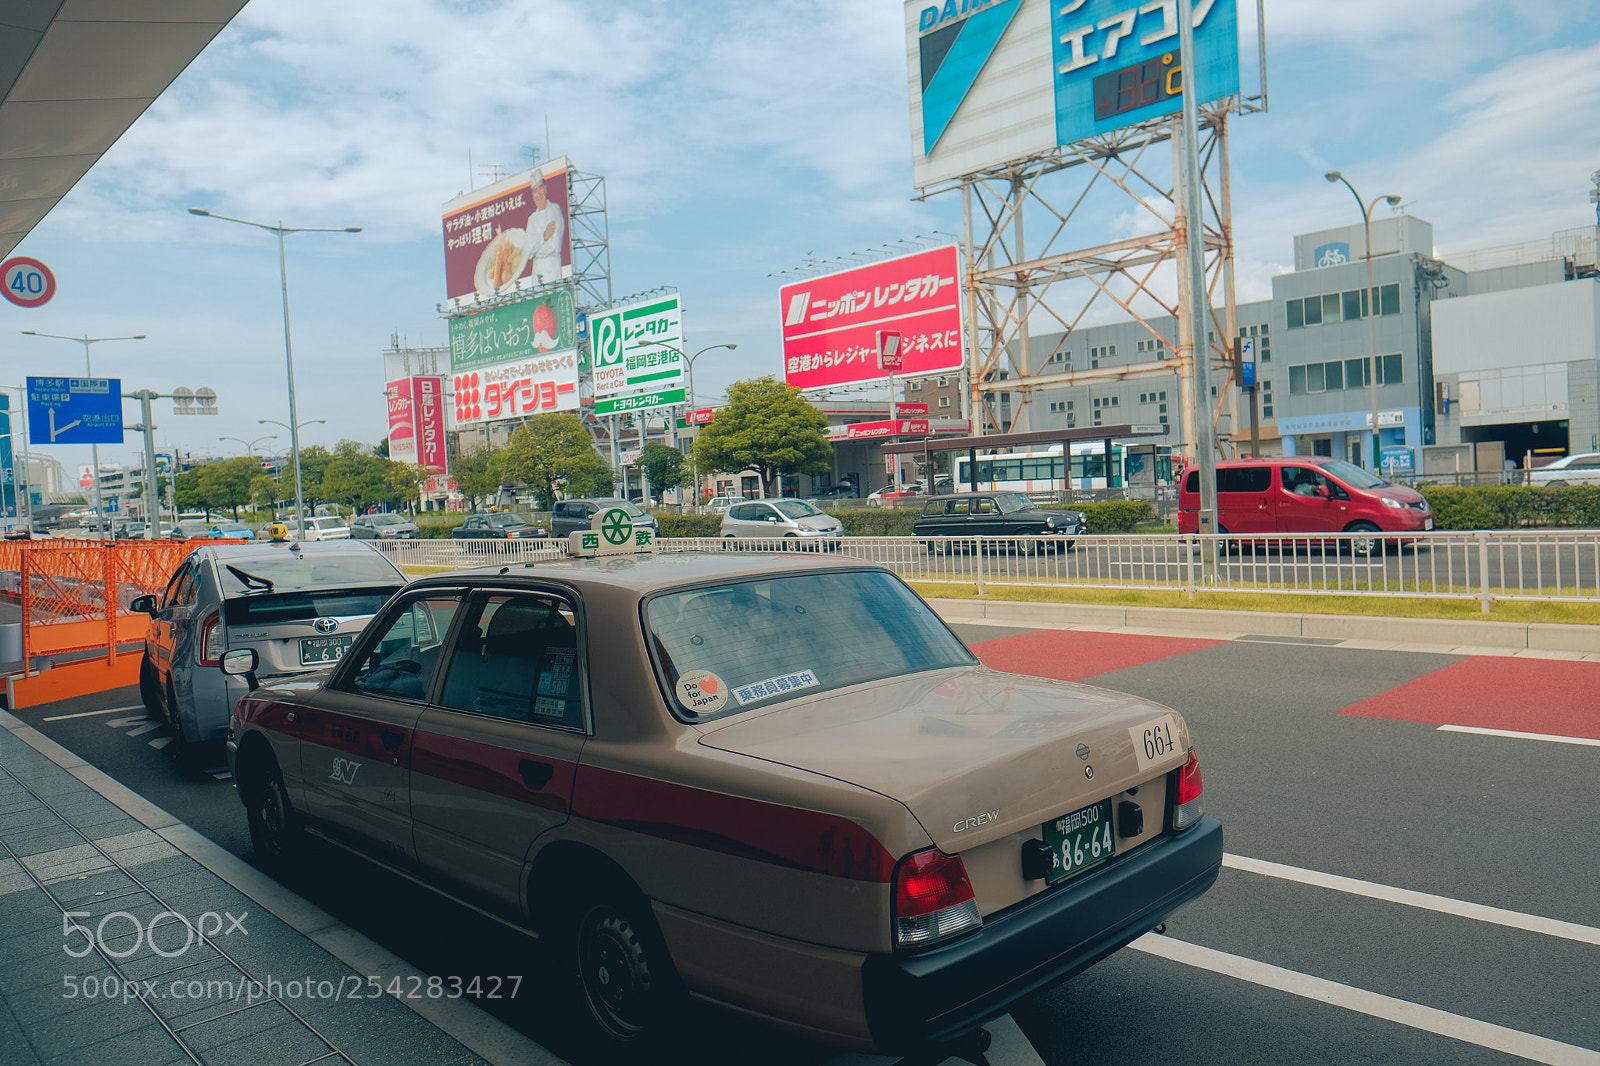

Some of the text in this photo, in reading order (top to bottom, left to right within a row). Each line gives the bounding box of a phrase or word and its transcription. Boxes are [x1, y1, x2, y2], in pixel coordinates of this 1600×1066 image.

[11, 271, 42, 294] 40
[810, 274, 954, 322] ニッポンレンタカー
[624, 318, 679, 341] レンタカー
[626, 348, 680, 371] 福岡空港店
[595, 367, 624, 381] TOYOTA
[596, 381, 609, 391] Rent
[614, 380, 625, 388] Car
[484, 378, 575, 417] ダイショー
[613, 395, 664, 410] トヨタレンタカー
[82, 414, 119, 422] 空港出口
[582, 530, 652, 550] 西 鉄
[684, 683, 698, 691] Do
[688, 690, 701, 699] for
[738, 672, 813, 702] 乗務員募集中
[692, 694, 719, 707] Japan
[1142, 722, 1174, 760] 664
[953, 809, 1000, 833] CREW
[1061, 821, 1112, 872] 86-64
